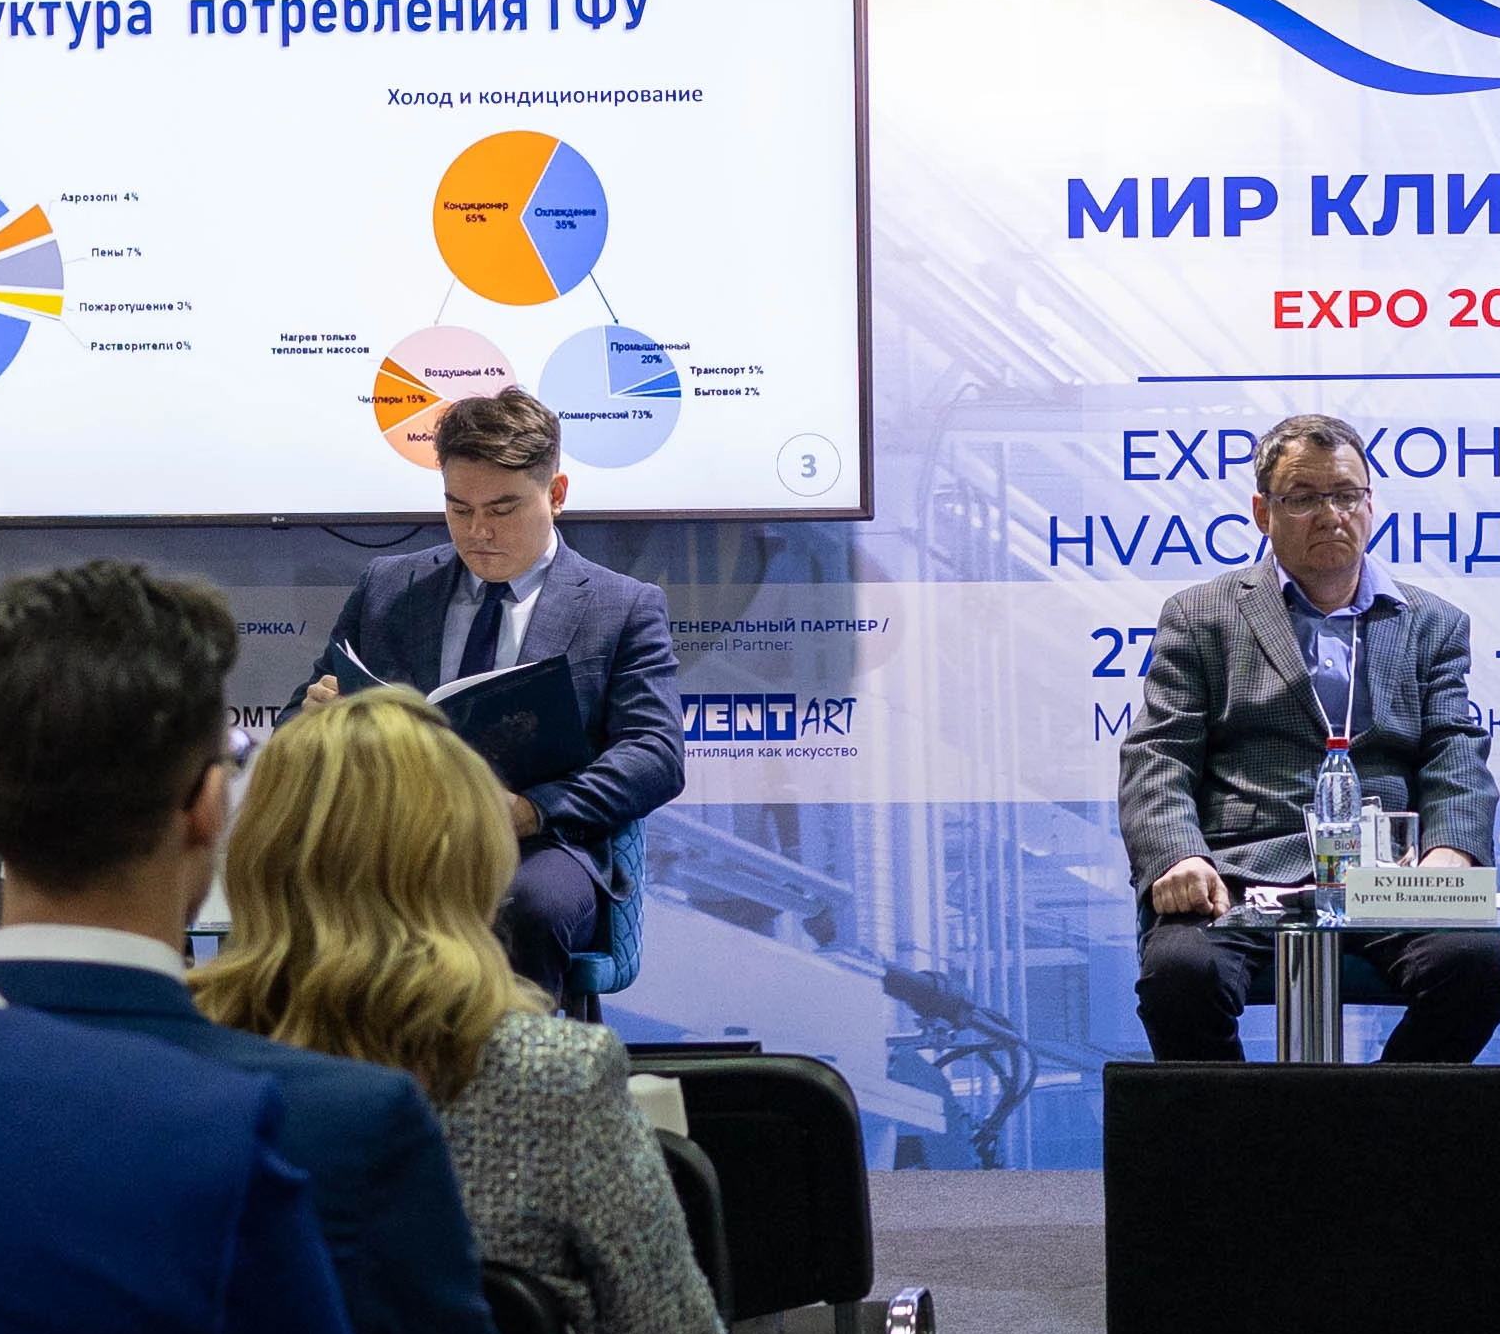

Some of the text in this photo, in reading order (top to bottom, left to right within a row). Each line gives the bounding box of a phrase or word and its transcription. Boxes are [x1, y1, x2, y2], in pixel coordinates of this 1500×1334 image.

[387, 87, 704, 108] Холод и кондиционирование
[60, 193, 140, 204] Аэрозоли 4%
[443, 200, 509, 214] Кондиционер
[1066, 177, 1280, 240] МИР
[465, 213, 487, 224] 65%
[534, 208, 597, 221] Охлаждение
[555, 220, 577, 231] 35%
[91, 247, 142, 258] Пены 7%
[79, 301, 193, 313] Пожаротушение 3%
[1273, 289, 1428, 331] EXPO
[280, 333, 357, 344] Нагрев только
[90, 341, 173, 353] Растворители
[271, 346, 370, 356] тепловых насосов
[610, 340, 691, 353] Промышленный
[640, 354, 663, 365] 20%
[424, 367, 506, 379] Воздушный 45%
[689, 365, 764, 377] Транспорт 5%
[694, 386, 760, 397] Бытовой 2%
[357, 394, 427, 406] Чиллеры 15%
[631, 409, 653, 420] 73%
[1122, 427, 1258, 481] EXP
[800, 454, 818, 478] 3
[236, 621, 296, 635] ЕРЖКА
[669, 618, 796, 634] ГЕНЕРАЛЬНЫЙ
[800, 620, 878, 633] ПАРТНЕР
[671, 639, 729, 653] General
[1090, 626, 1157, 678] 27
[684, 746, 858, 760] ентиляция как искусство
[1374, 876, 1465, 888] КУШНЕРЕВ
[1351, 892, 1487, 905] Артем Владиленович
